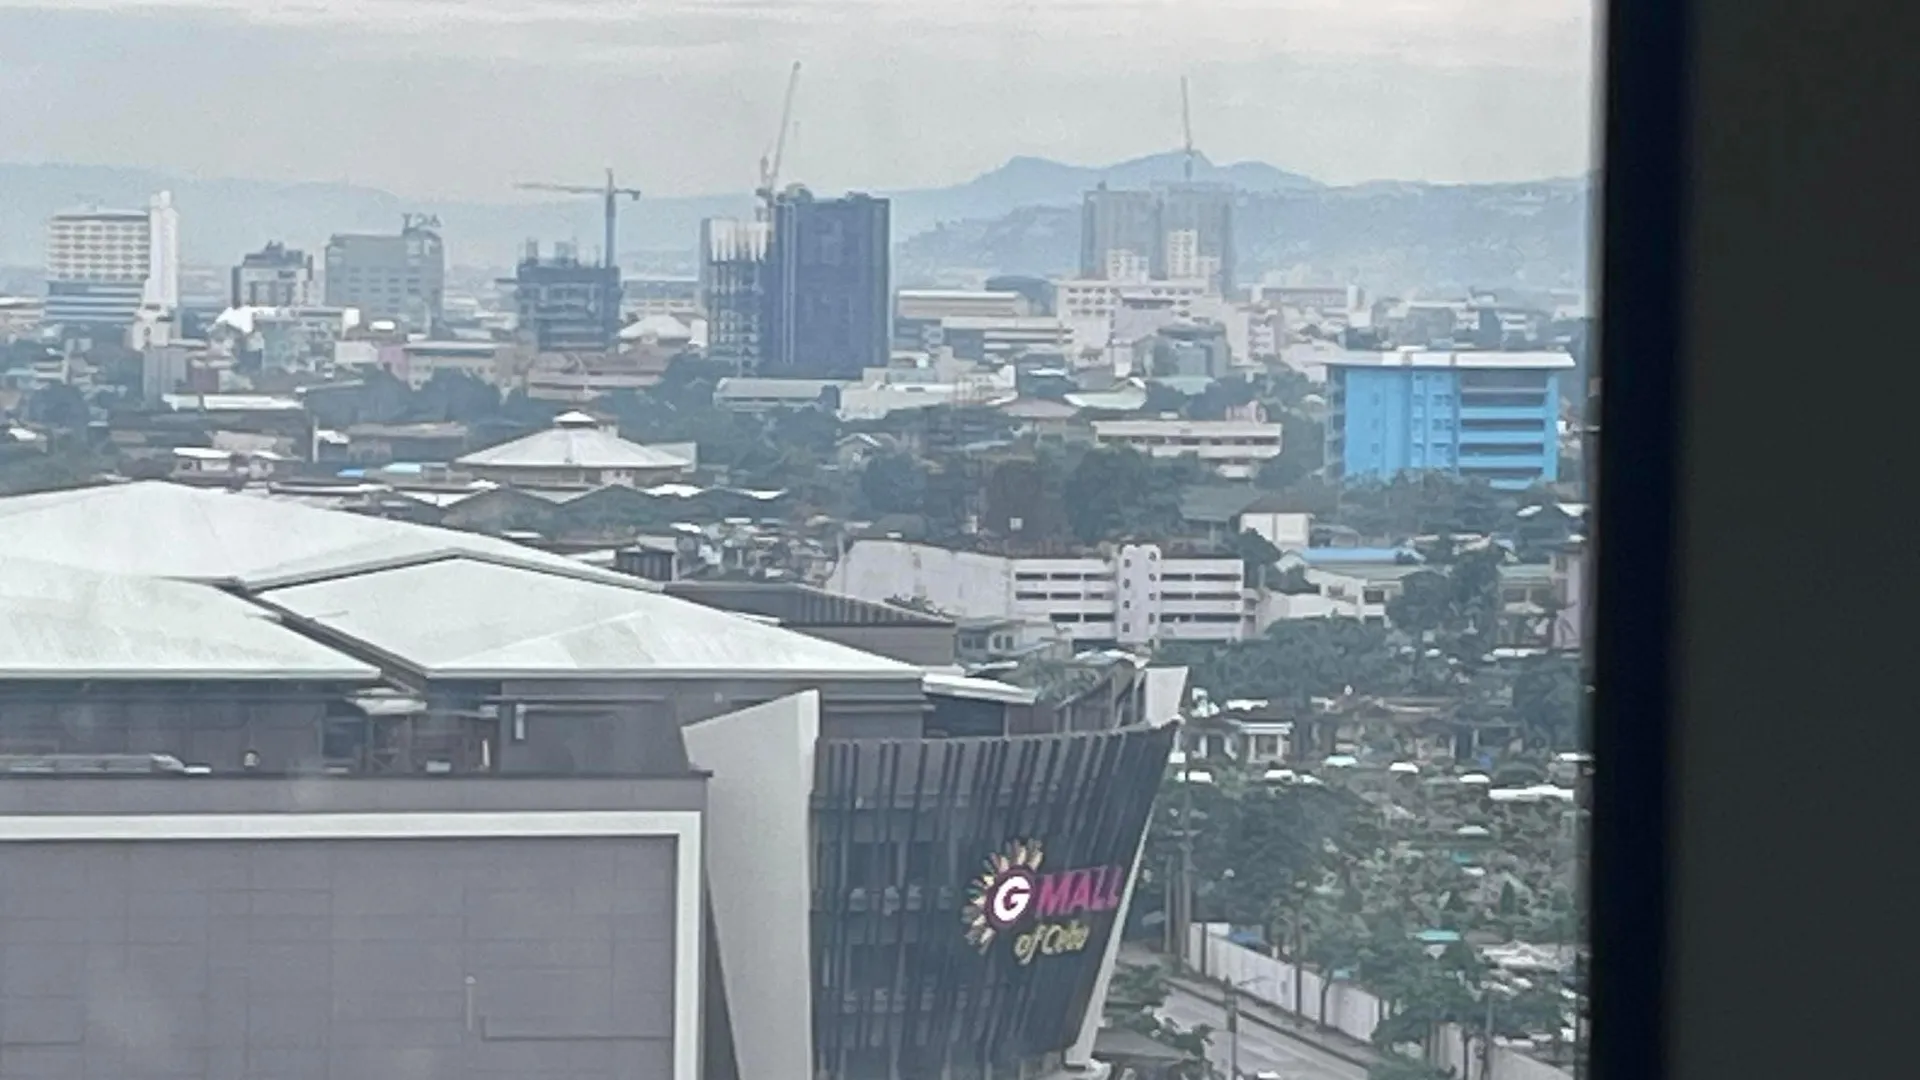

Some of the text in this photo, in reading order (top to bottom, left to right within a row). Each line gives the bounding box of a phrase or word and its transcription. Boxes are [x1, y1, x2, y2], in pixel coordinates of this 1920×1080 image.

[993, 865, 1123, 922] G MALL
[1014, 924, 1046, 966] of
